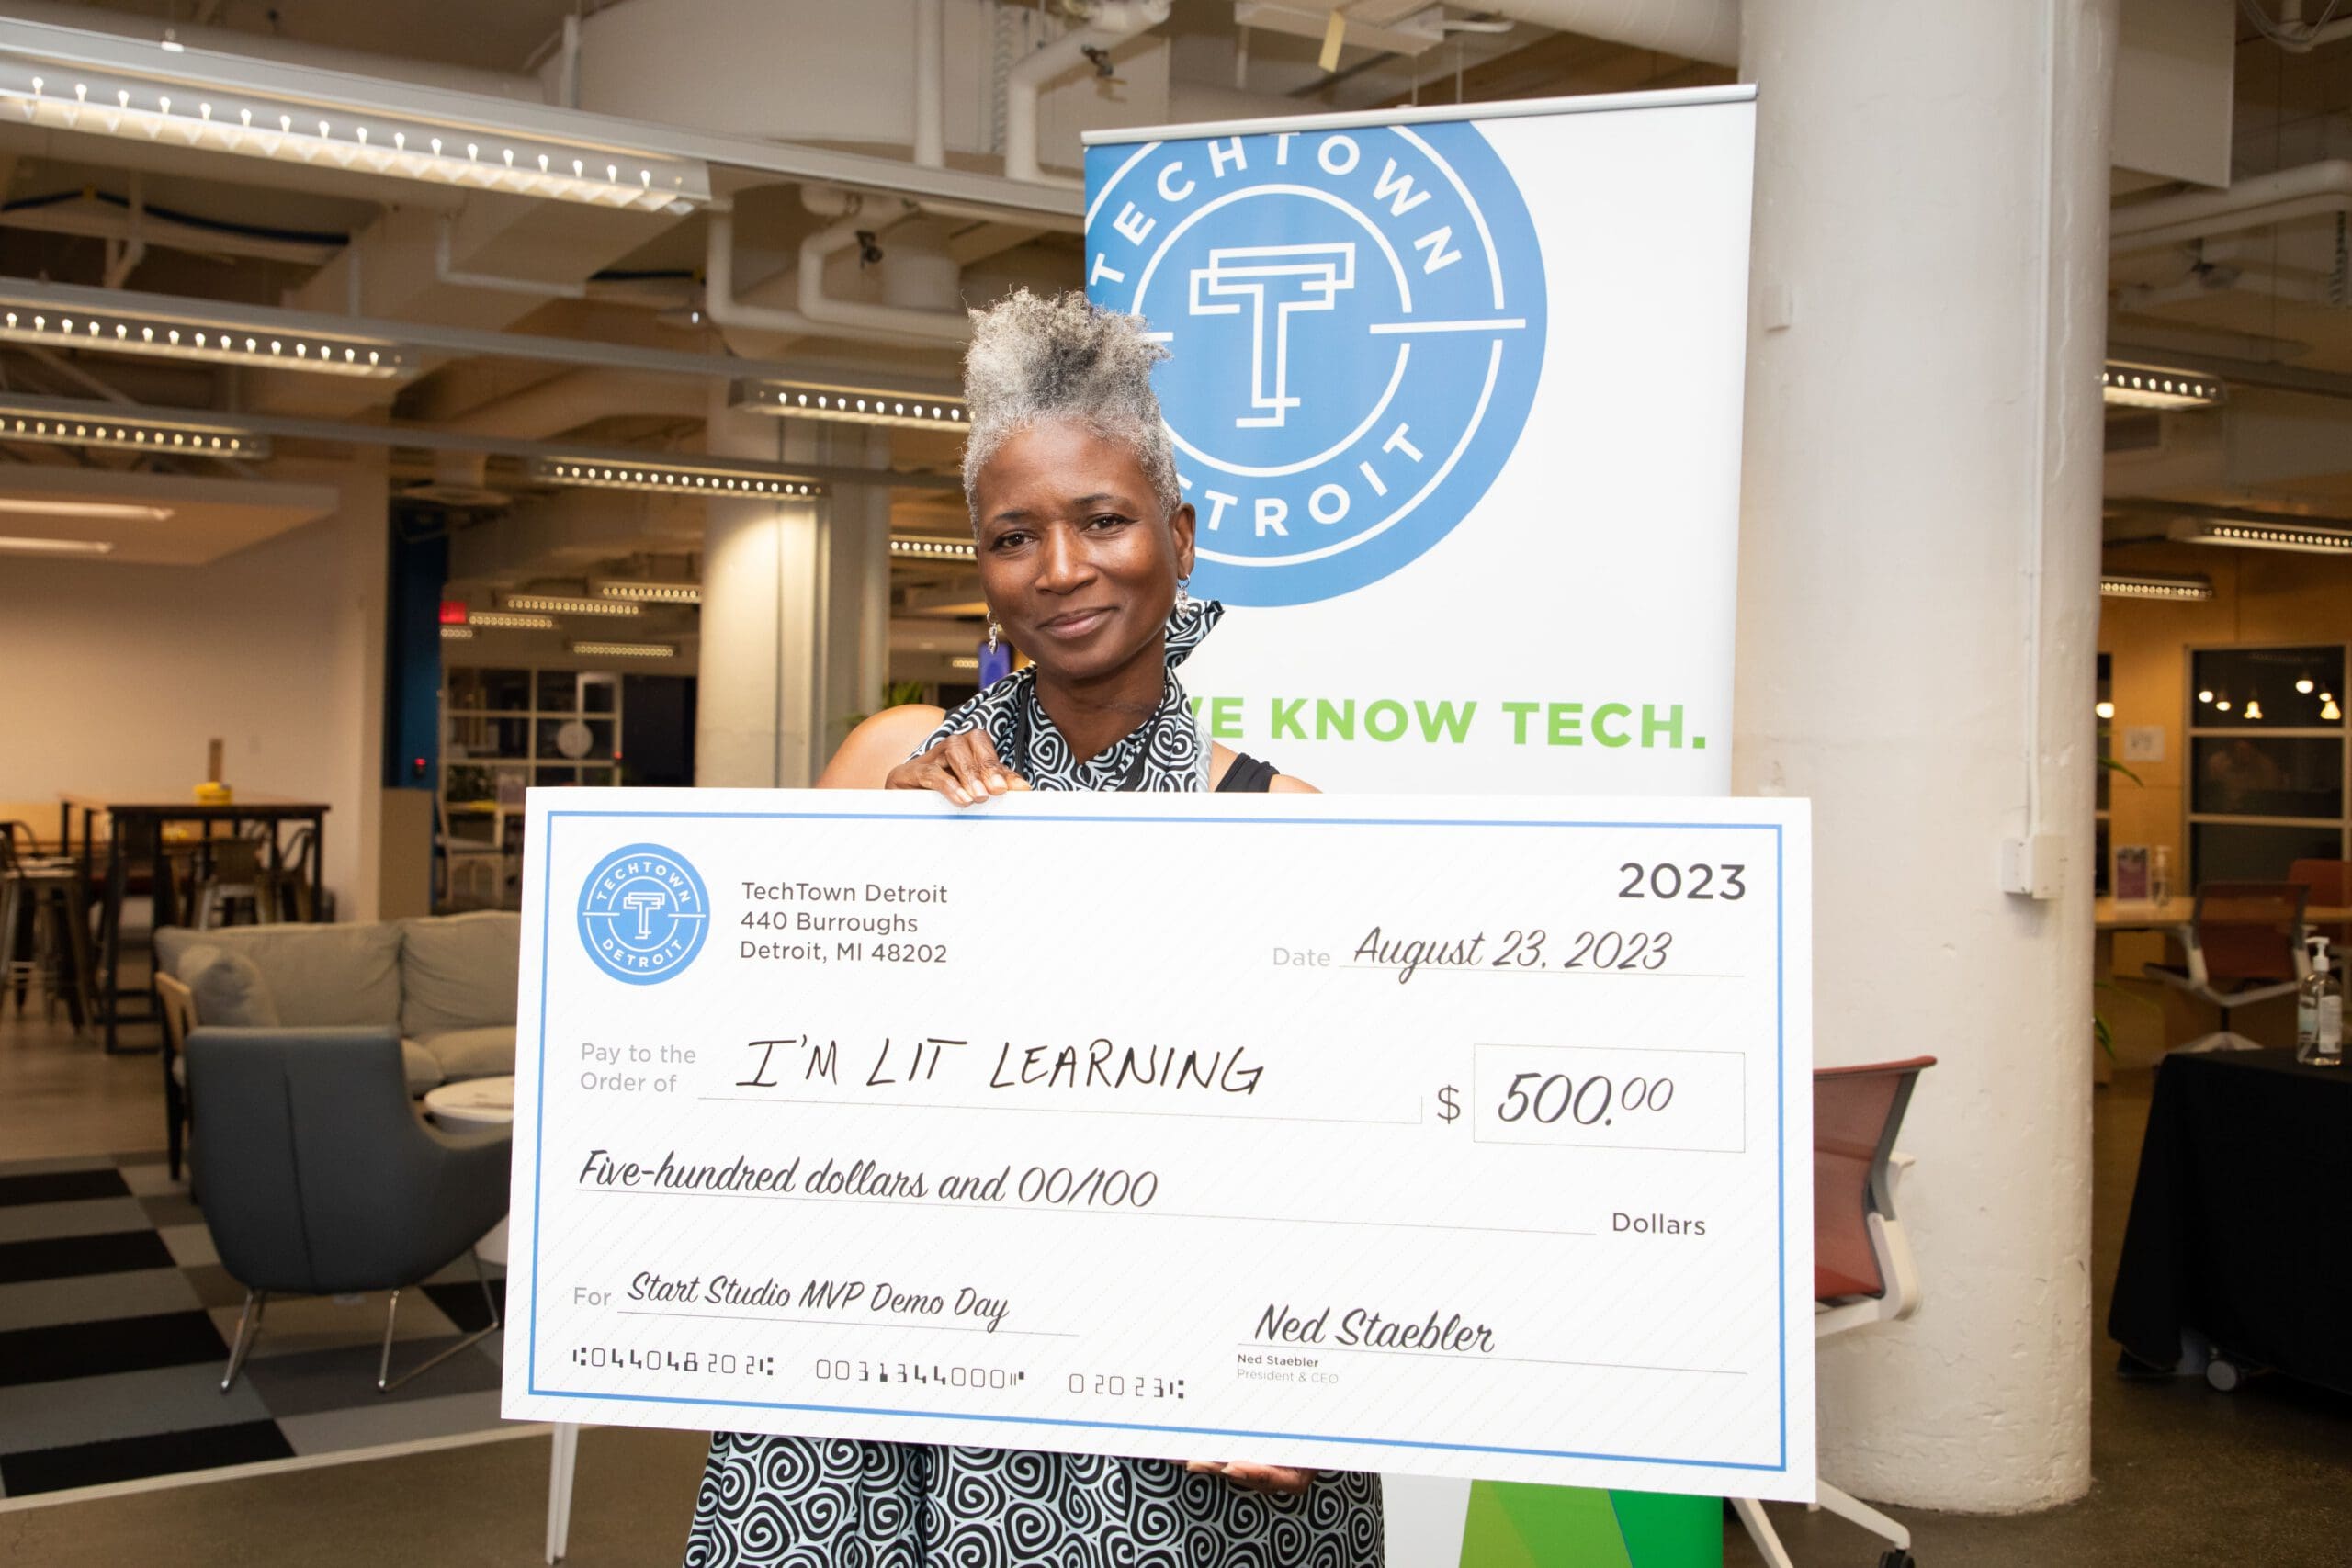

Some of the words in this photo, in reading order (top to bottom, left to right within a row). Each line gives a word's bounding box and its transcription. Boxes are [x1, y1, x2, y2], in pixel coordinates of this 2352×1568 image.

[1090, 132, 1463, 287] TECHTOWN
[1176, 423, 1424, 537] TROIT
[1271, 696, 1477, 744] KNOW
[1501, 700, 1706, 750] TECH.
[596, 861, 692, 904] TECHTOWN
[741, 881, 856, 902] TechTown
[865, 883, 948, 904] Detroit
[1618, 862, 1746, 901] 2023
[741, 910, 787, 931] 440
[797, 911, 918, 936] Burroughs
[602, 938, 683, 968] DETROIT
[741, 940, 827, 964] Detroit,
[836, 942, 862, 961] MI
[871, 943, 947, 964] 48202
[1273, 946, 1331, 967] Date
[1354, 926, 1484, 985] August
[1564, 931, 1672, 970] 2023
[581, 1042, 621, 1066] Pay
[628, 1044, 652, 1063] to
[660, 1043, 696, 1065] the
[735, 1033, 838, 1088] I'M
[865, 1037, 967, 1088] LIT
[989, 1038, 1265, 1097] LEARNING
[580, 1071, 647, 1093] Order
[653, 1073, 678, 1093] of
[1436, 1083, 1462, 1126] $
[579, 1149, 798, 1193] Five-hundred
[805, 1158, 930, 1199] dollars
[938, 1166, 1012, 1201] and
[1018, 1167, 1159, 1208] 00/100
[1612, 1212, 1706, 1236] Dollars
[572, 1285, 613, 1306] For
[627, 1271, 700, 1303] Start
[704, 1275, 791, 1308] Studio
[798, 1280, 865, 1310] MVP
[870, 1282, 944, 1315] Demo
[954, 1287, 1009, 1334] Day
[1254, 1303, 1330, 1344] Ned
[1335, 1308, 1495, 1353] Staebler
[1237, 1353, 1263, 1366] Ned
[1266, 1355, 1320, 1369] Staebler
[1237, 1368, 1295, 1382] President
[1297, 1371, 1307, 1383] &
[1310, 1372, 1340, 1385] CEO
